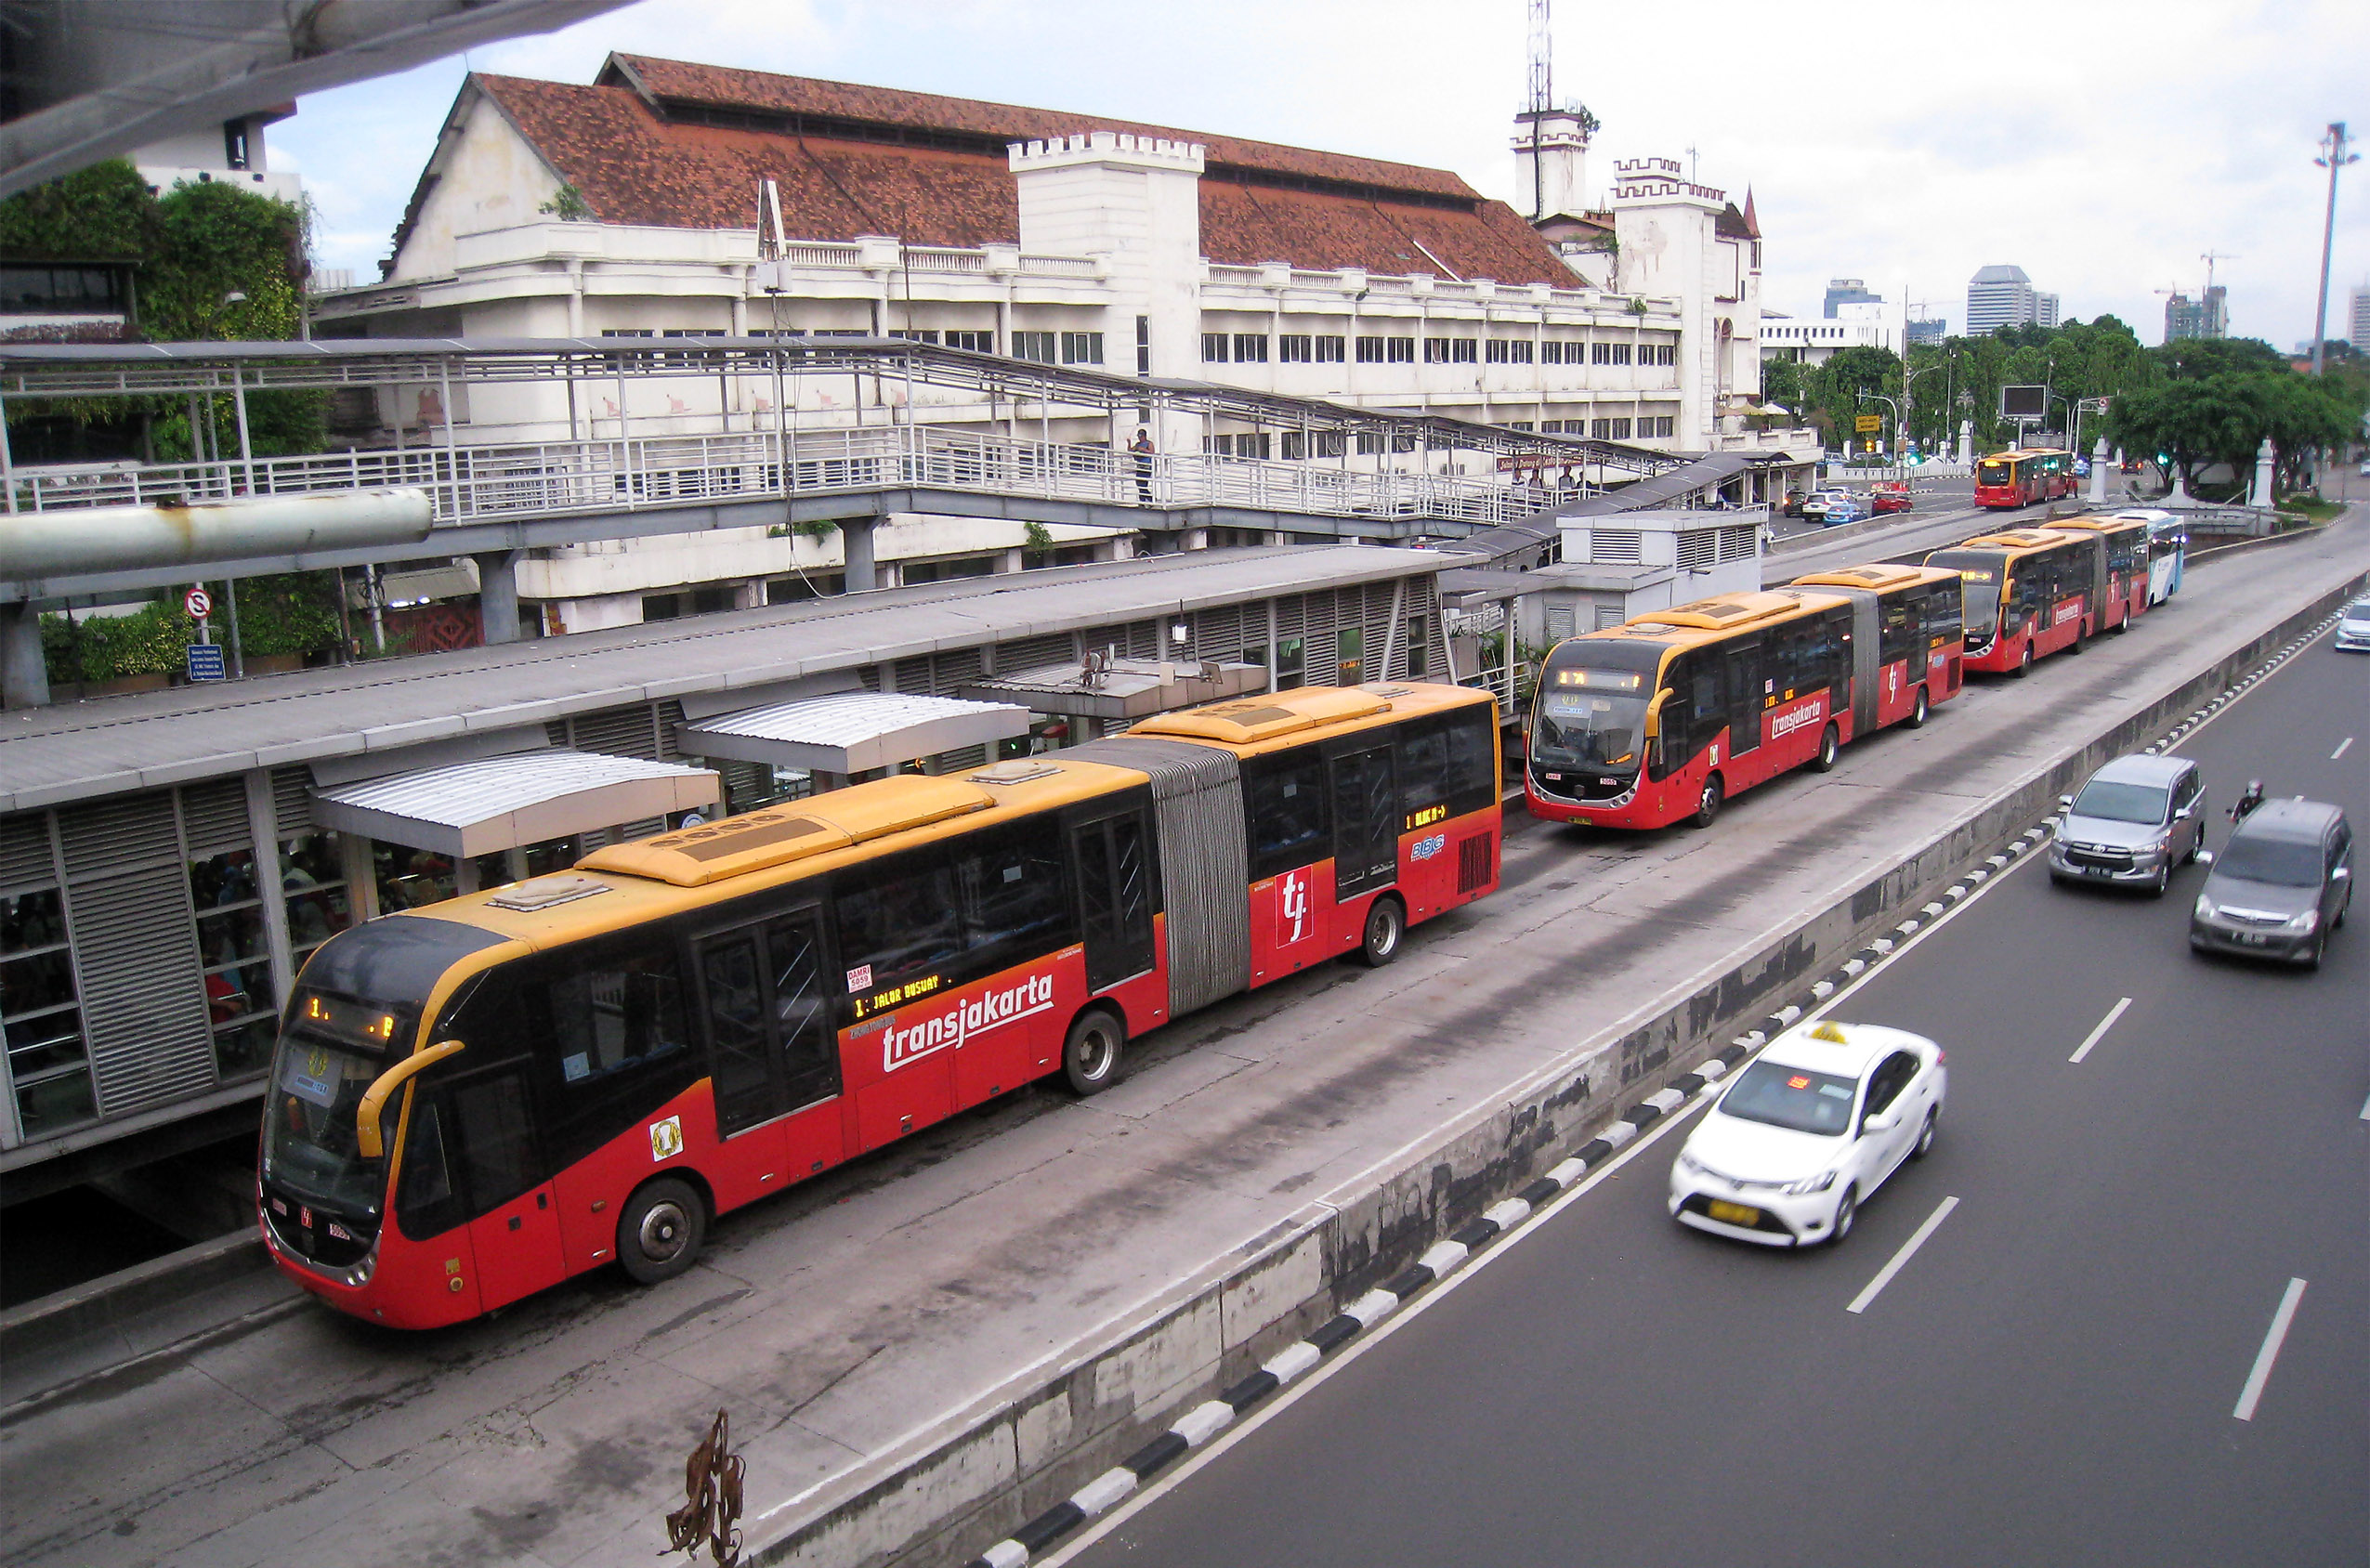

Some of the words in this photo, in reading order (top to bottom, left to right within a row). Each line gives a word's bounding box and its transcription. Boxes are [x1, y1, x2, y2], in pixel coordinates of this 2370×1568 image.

[1771, 699, 1820, 739] transjakarta
[1410, 833, 1446, 858] BBG
[848, 966, 870, 980] DAMRI
[851, 975, 869, 987] 5059
[873, 988, 901, 1010] JALUR
[884, 973, 1054, 1072] transjakarta
